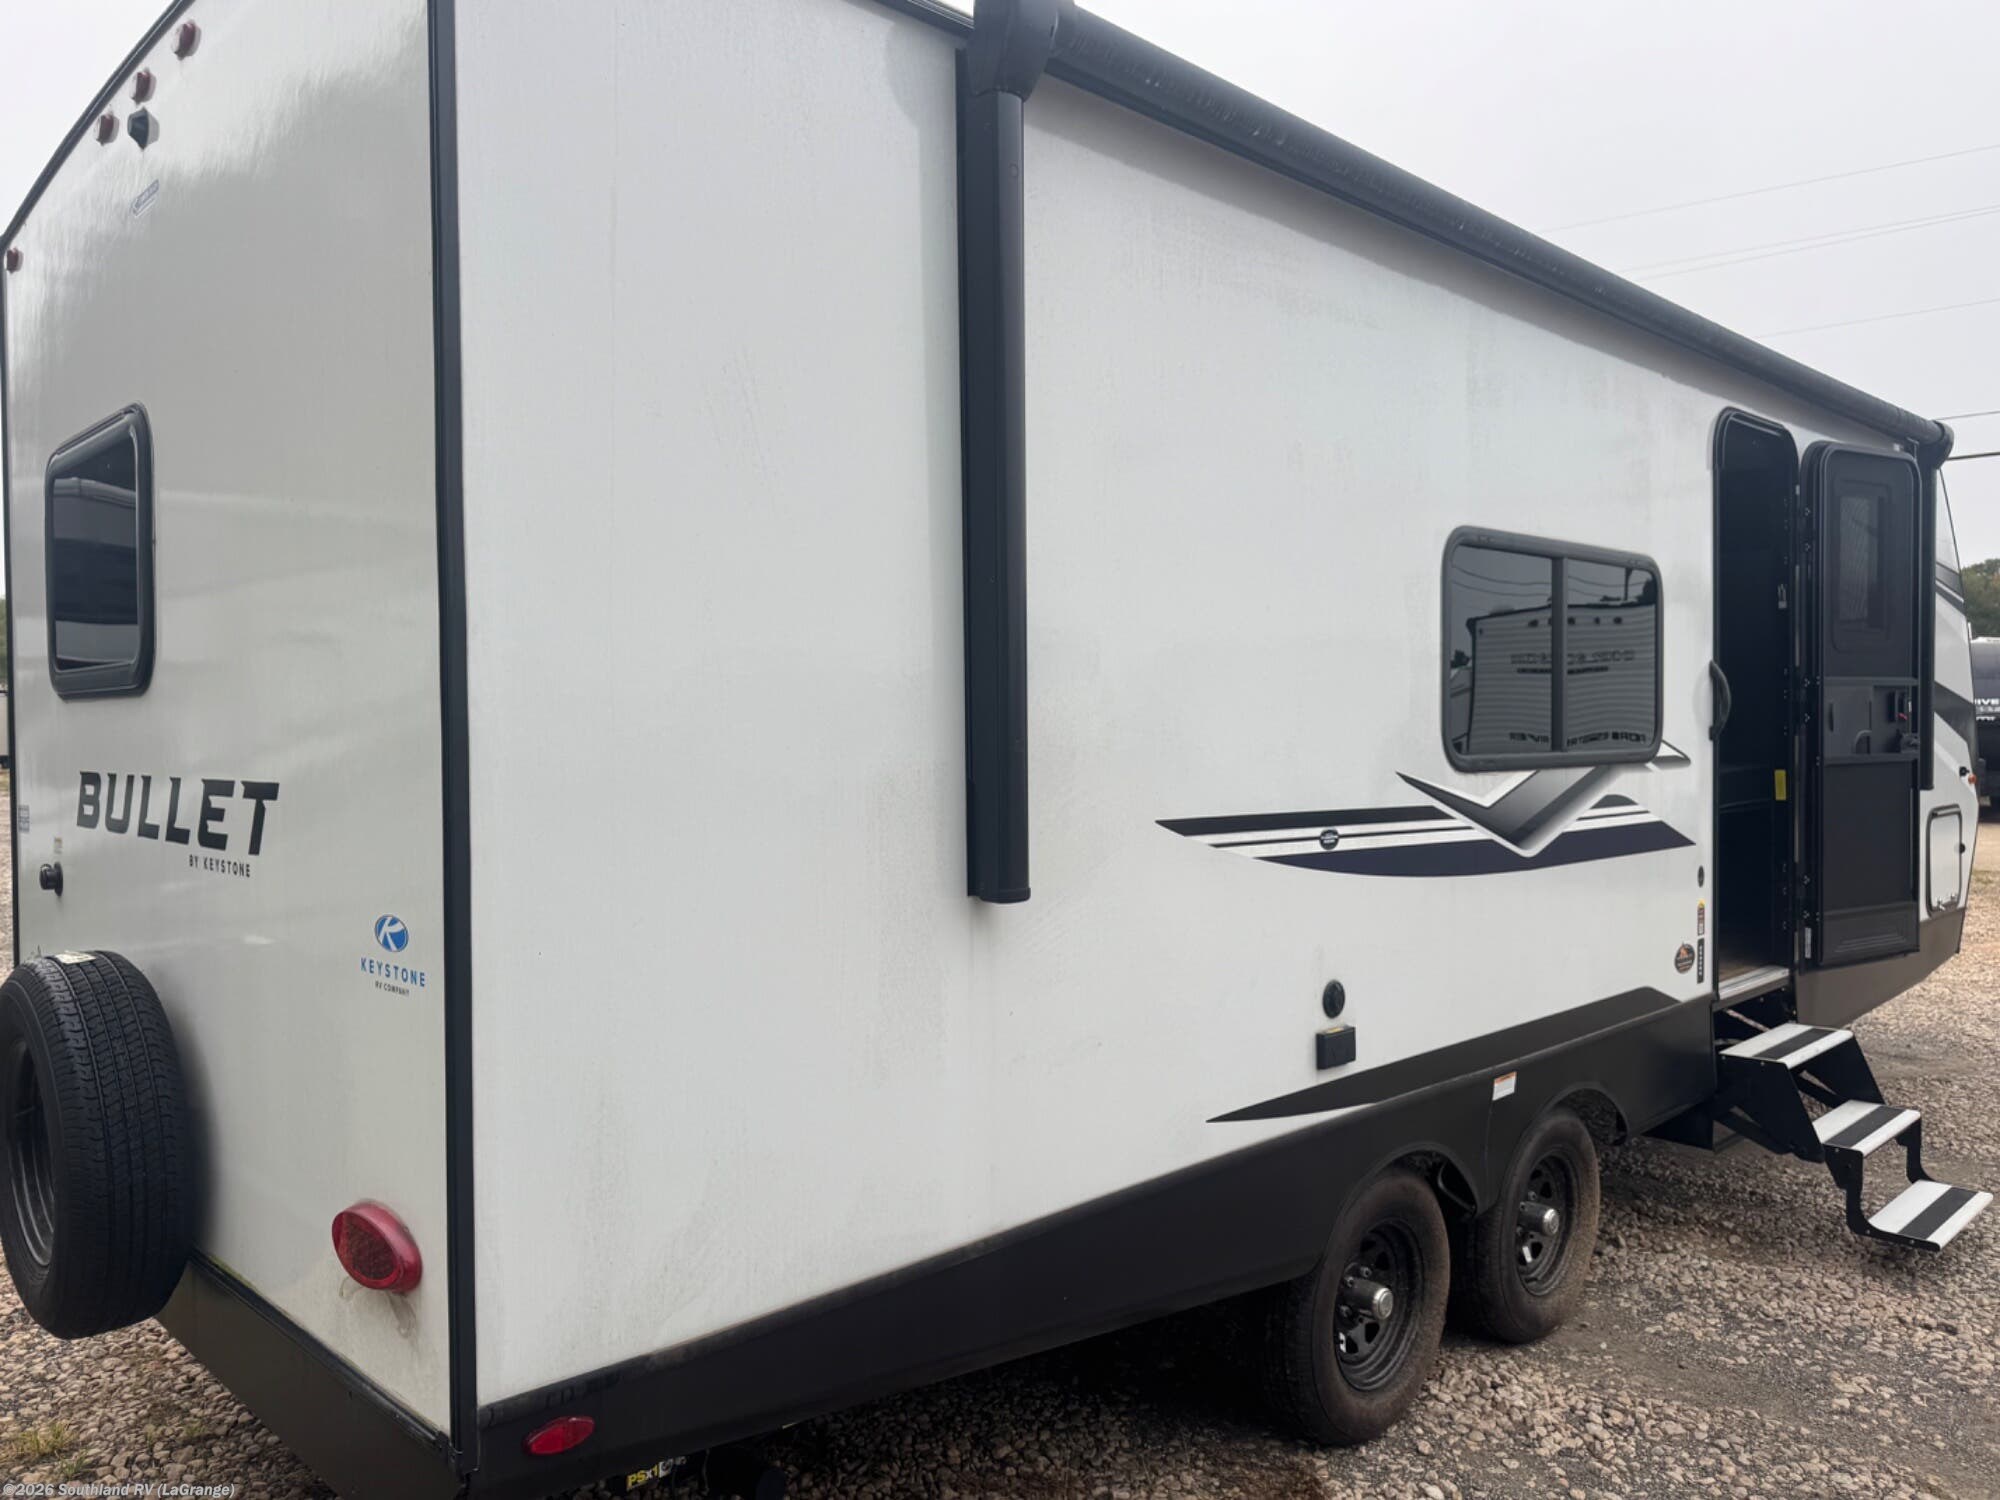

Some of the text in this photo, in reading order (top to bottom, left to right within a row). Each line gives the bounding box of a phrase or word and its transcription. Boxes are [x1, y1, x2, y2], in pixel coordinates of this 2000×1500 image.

[77, 771, 279, 855] BULLET
[189, 854, 251, 878] BY KEYSTONE
[360, 957, 426, 988] KEYSTONE
[375, 980, 410, 997] RV COMPANY
